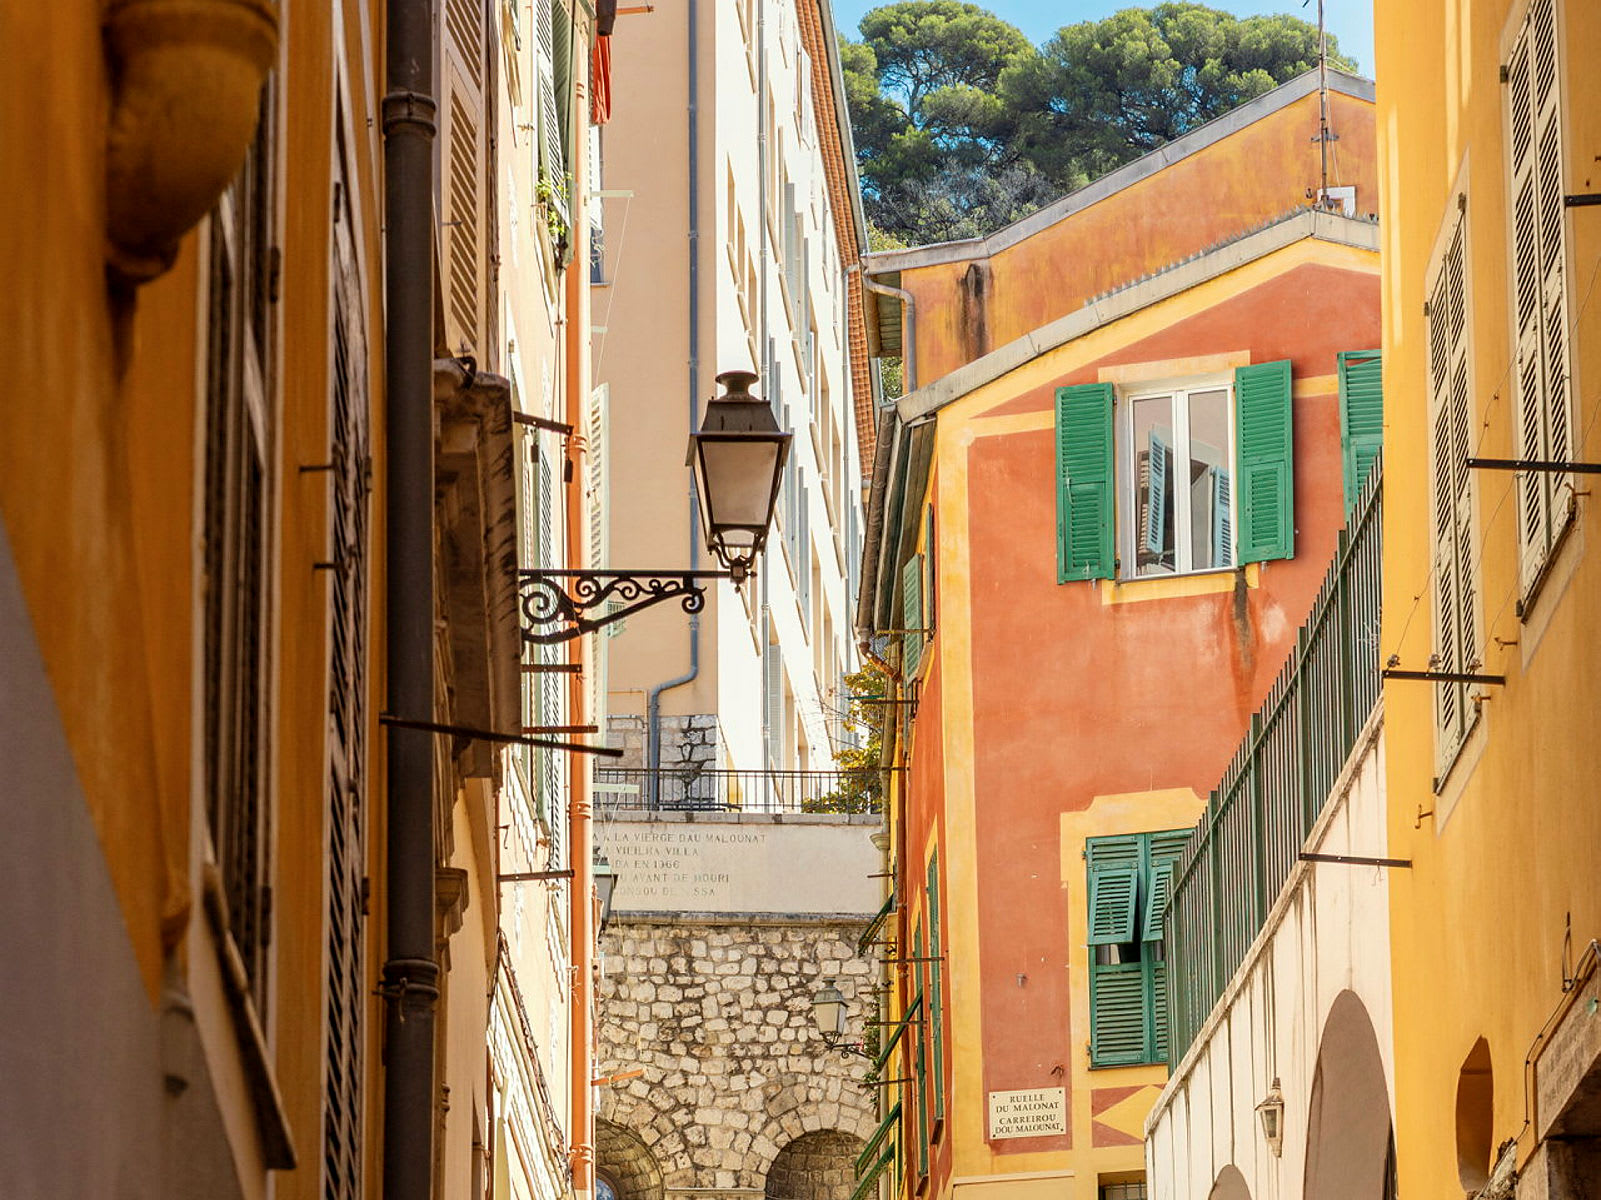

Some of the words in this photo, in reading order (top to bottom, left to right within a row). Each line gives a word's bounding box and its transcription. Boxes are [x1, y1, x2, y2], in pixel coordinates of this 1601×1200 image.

[634, 832, 675, 843] VIERGE
[678, 833, 700, 843] DAU
[705, 833, 767, 844] MALOUNAT
[1010, 1094, 1044, 1103] RUELLE
[996, 1105, 1009, 1113] DU
[1013, 1102, 1059, 1112] MALONAT
[999, 1114, 1056, 1125] CARREIROU
[1015, 1123, 1060, 1133] MALOUNAT
